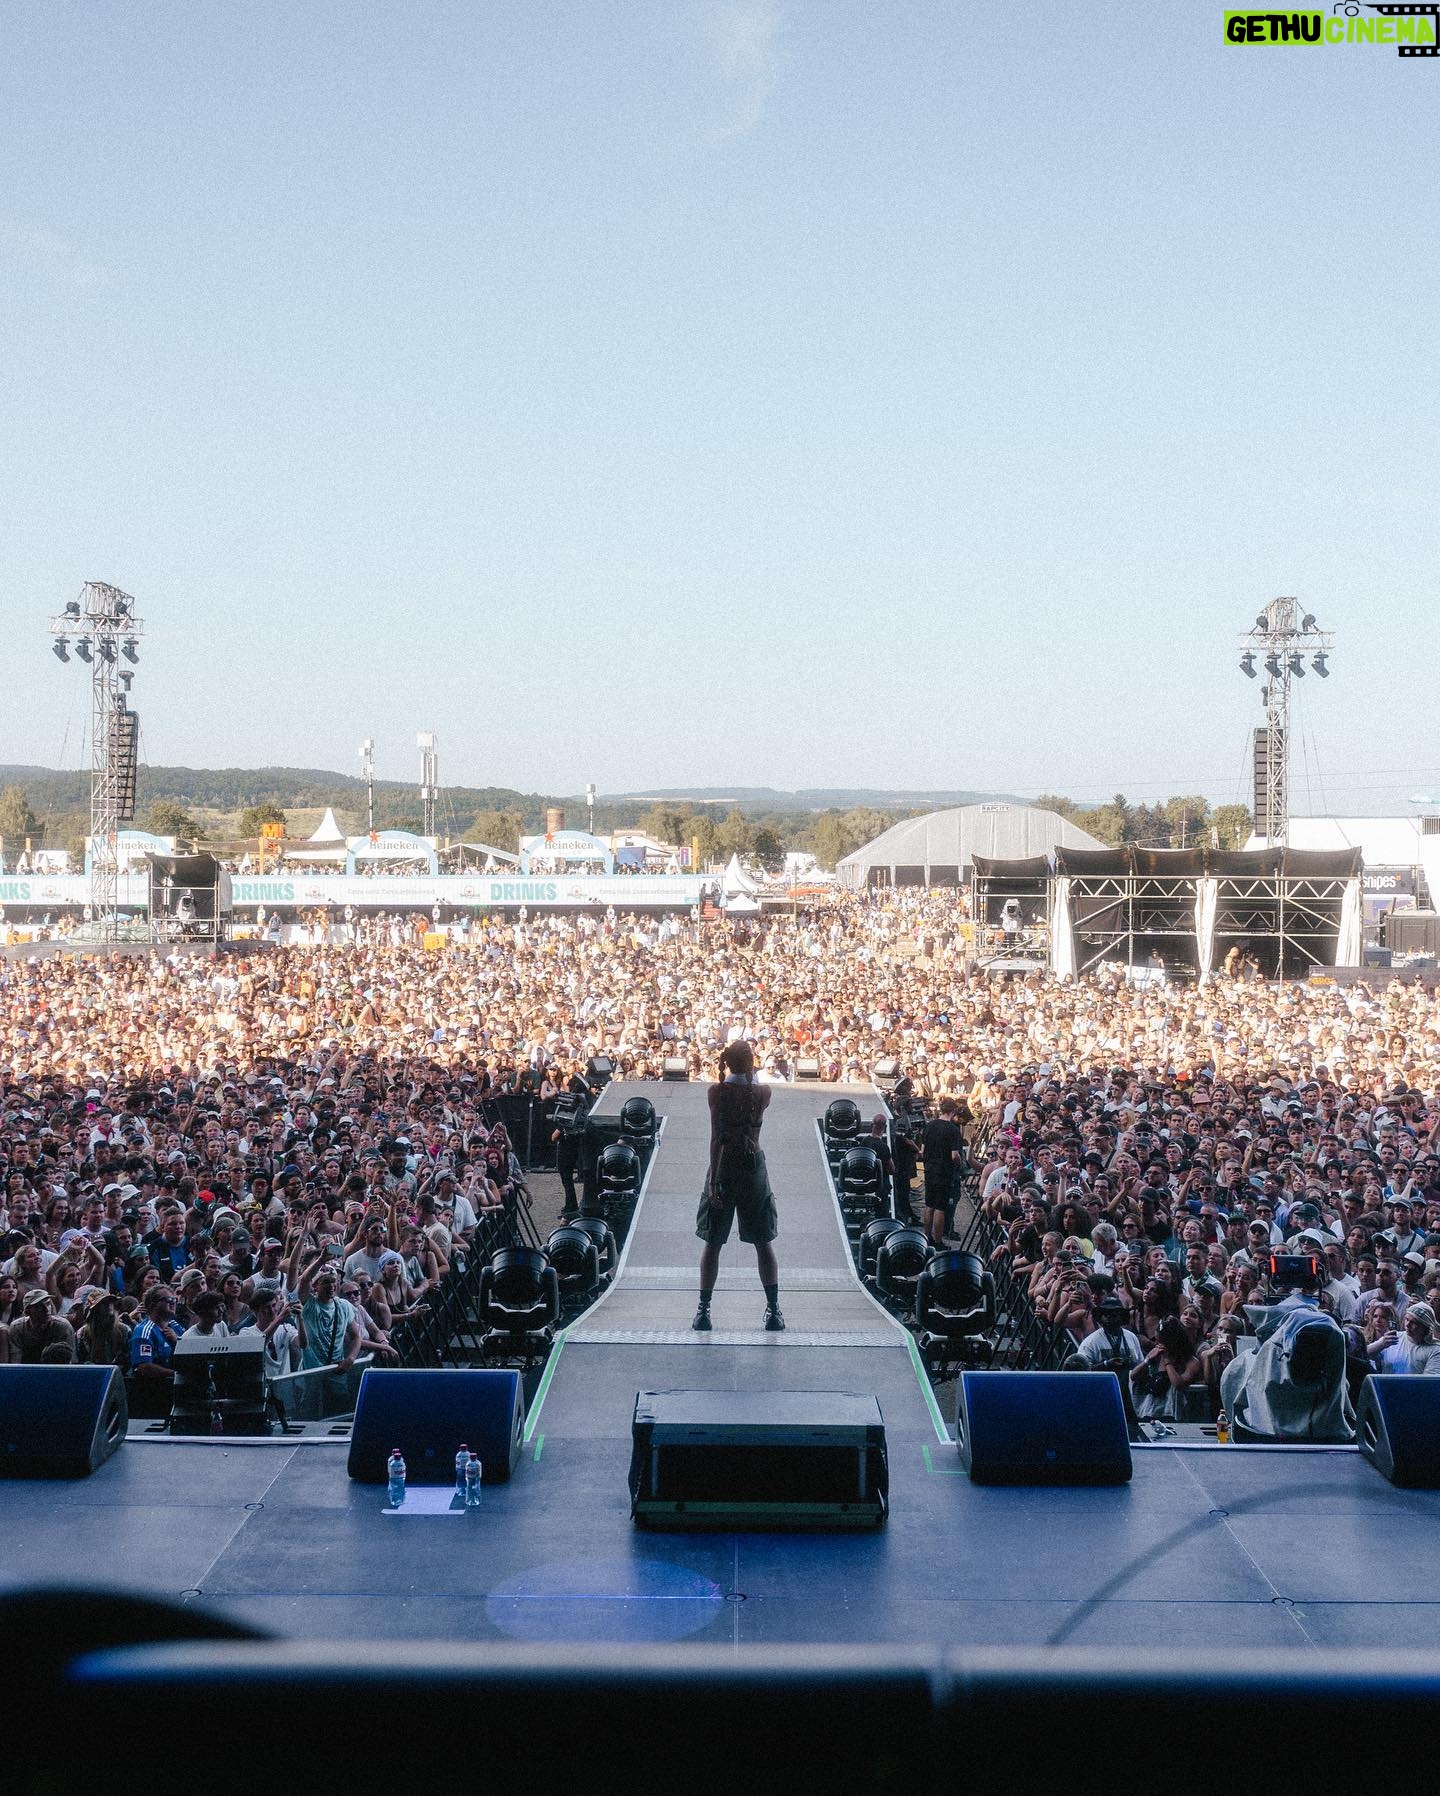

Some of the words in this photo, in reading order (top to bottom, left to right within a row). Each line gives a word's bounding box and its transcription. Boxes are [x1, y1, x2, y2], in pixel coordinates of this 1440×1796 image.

[107, 841, 157, 850] eineken
[370, 840, 419, 850] Heineken
[544, 840, 594, 850] Heineken
[1363, 875, 1396, 890] snipes
[231, 883, 295, 900] DRINKS
[490, 883, 557, 901] DRINKS
